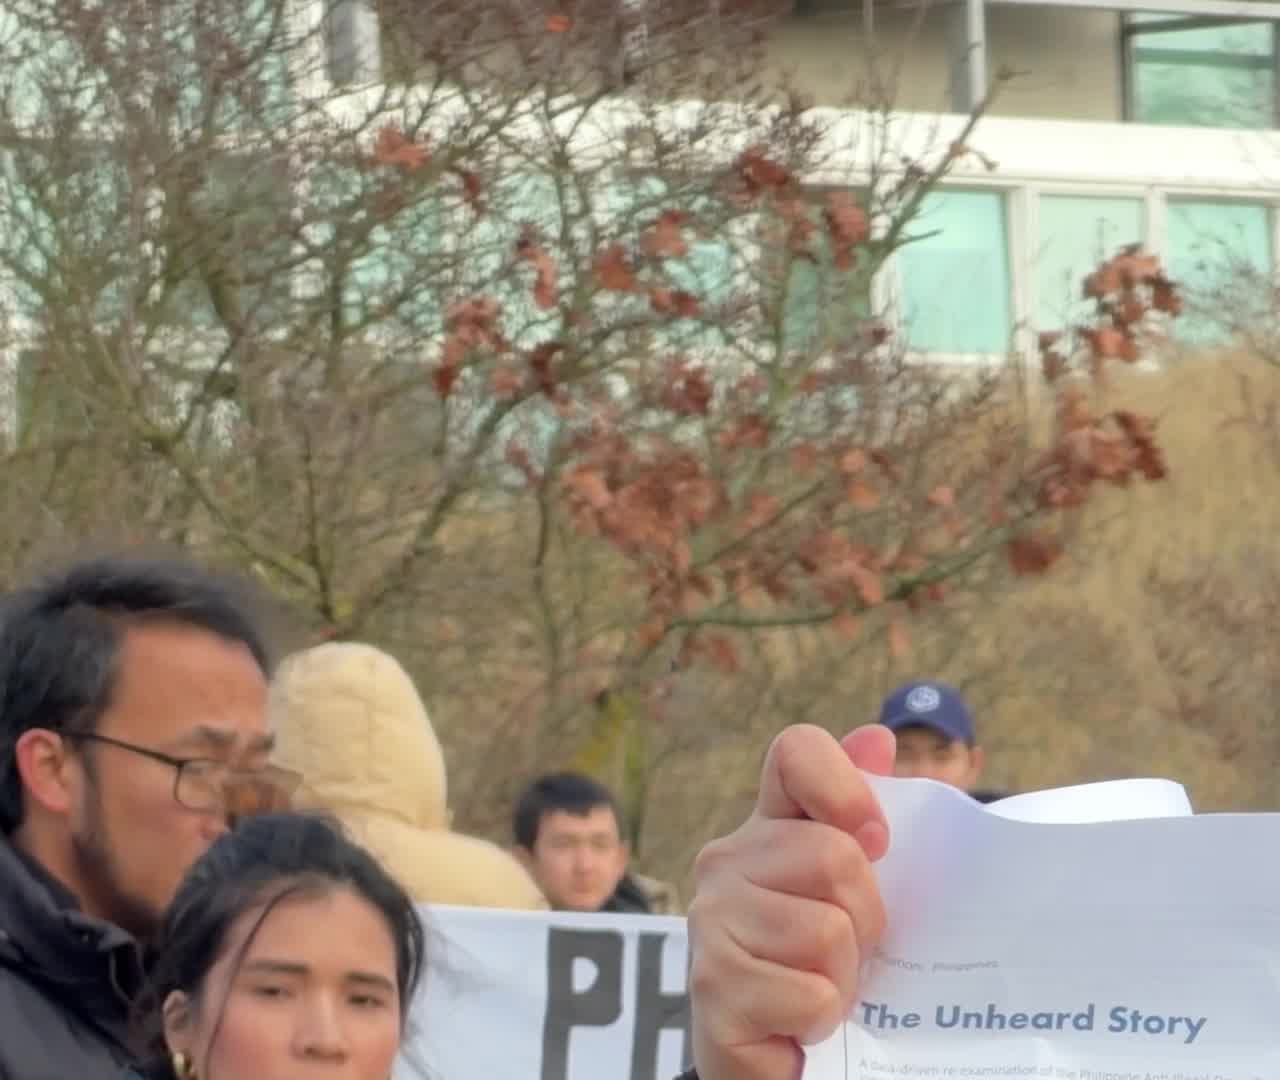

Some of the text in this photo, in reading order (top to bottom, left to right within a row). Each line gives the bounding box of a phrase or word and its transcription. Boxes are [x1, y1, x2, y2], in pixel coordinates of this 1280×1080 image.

[861, 1001, 1207, 1043] The Unheard Story
